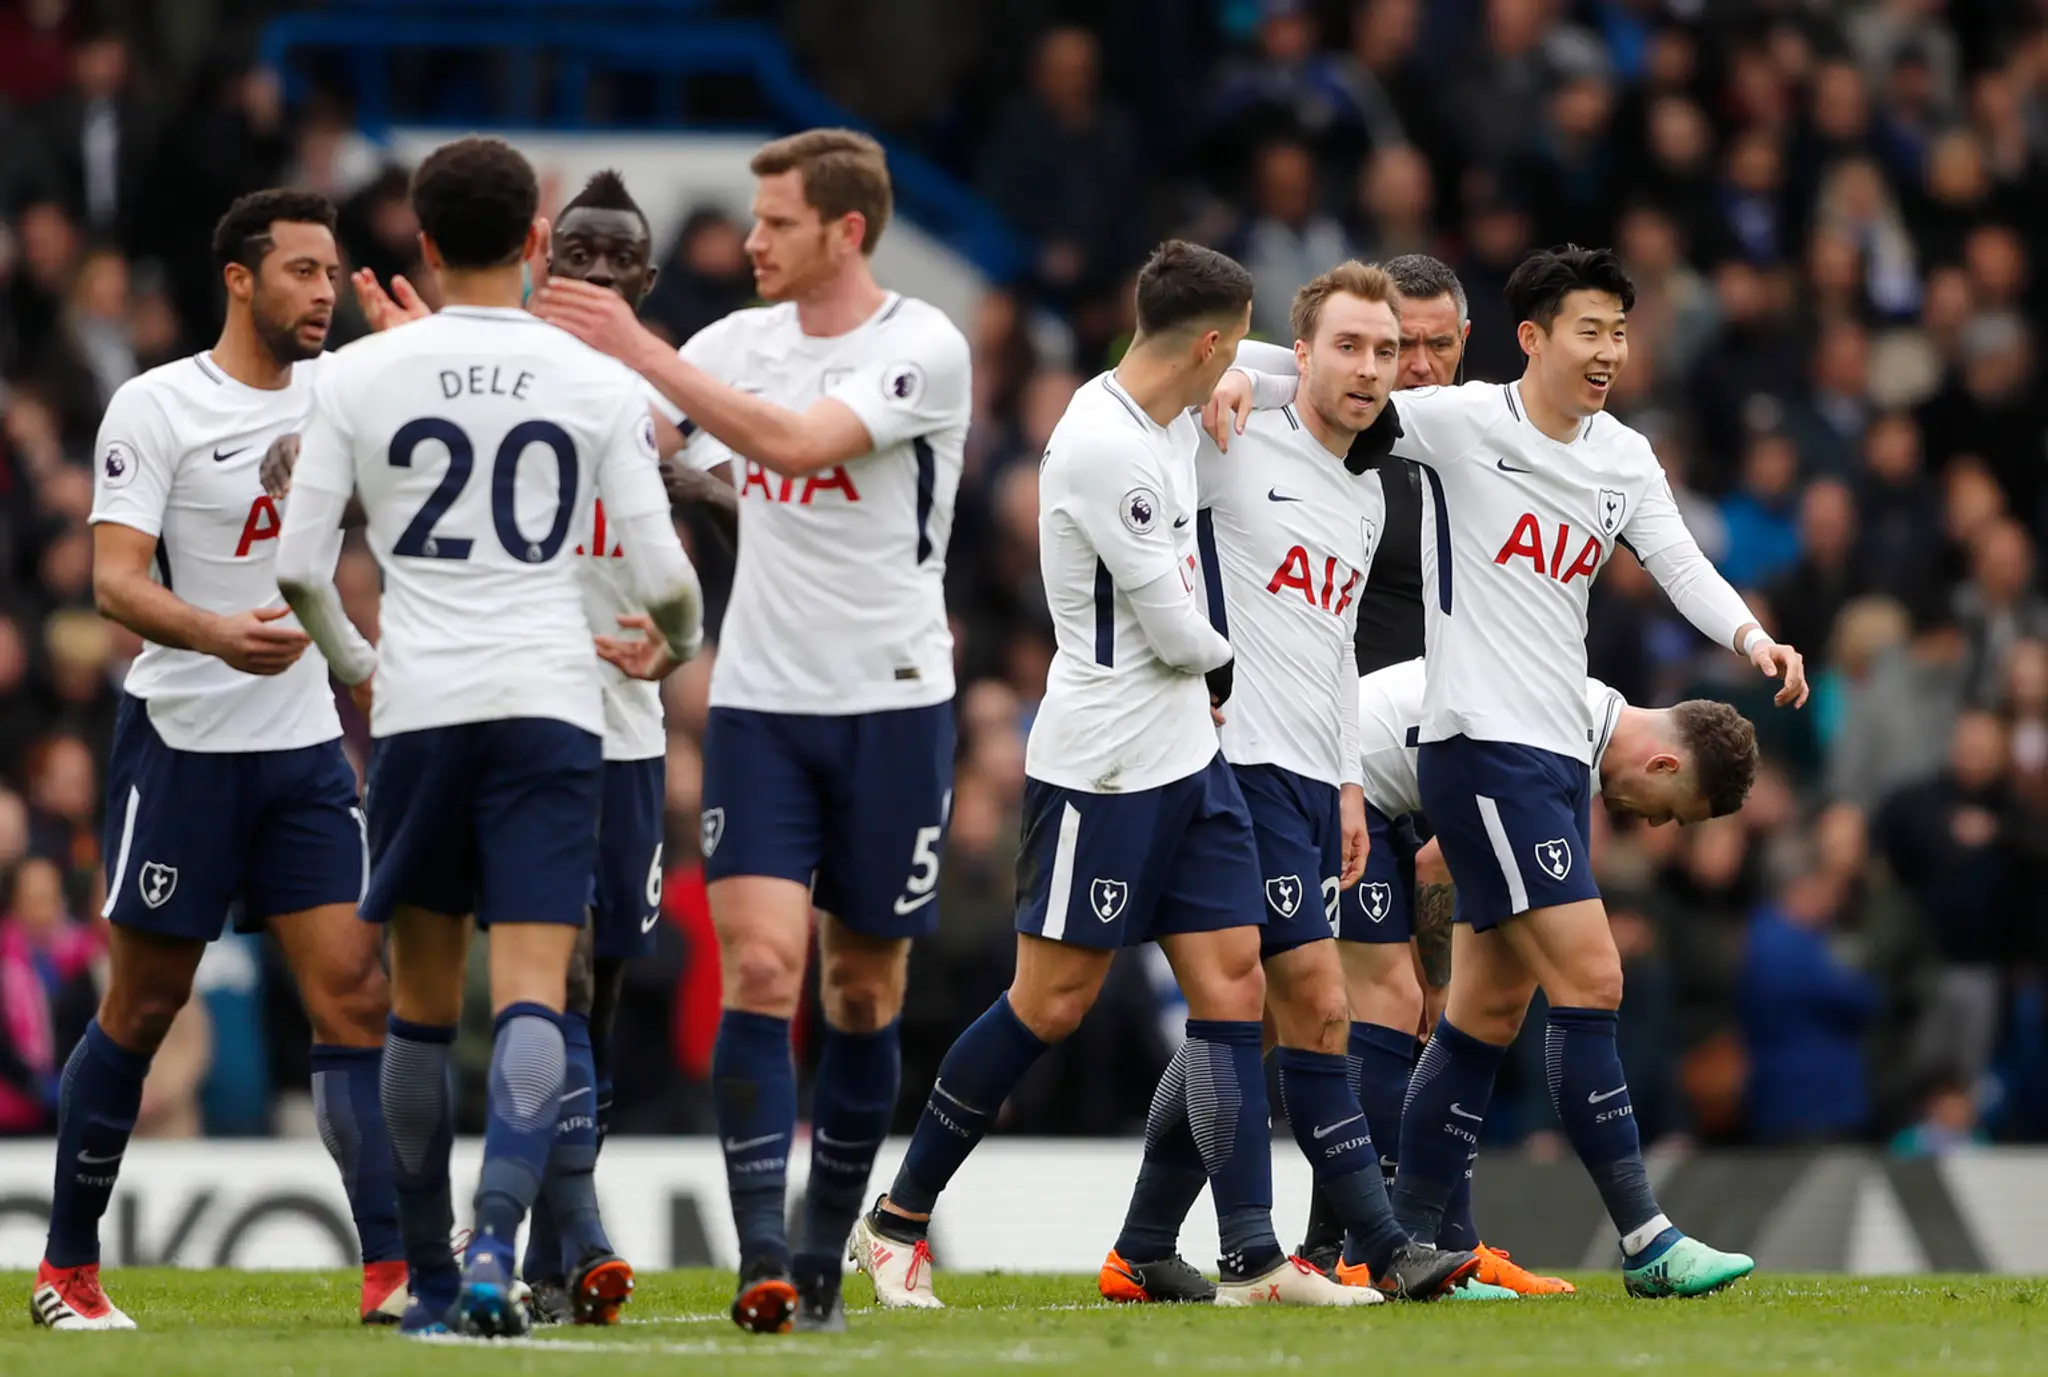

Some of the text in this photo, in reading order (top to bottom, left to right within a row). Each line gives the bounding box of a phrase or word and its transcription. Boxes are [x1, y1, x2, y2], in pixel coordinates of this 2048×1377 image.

[440, 365, 535, 401] DELE
[388, 417, 578, 564] 20
[1493, 512, 1602, 584] AIA
[645, 841, 664, 908] 6
[906, 825, 942, 895] 5
[1325, 1134, 1372, 1158] SPURS
